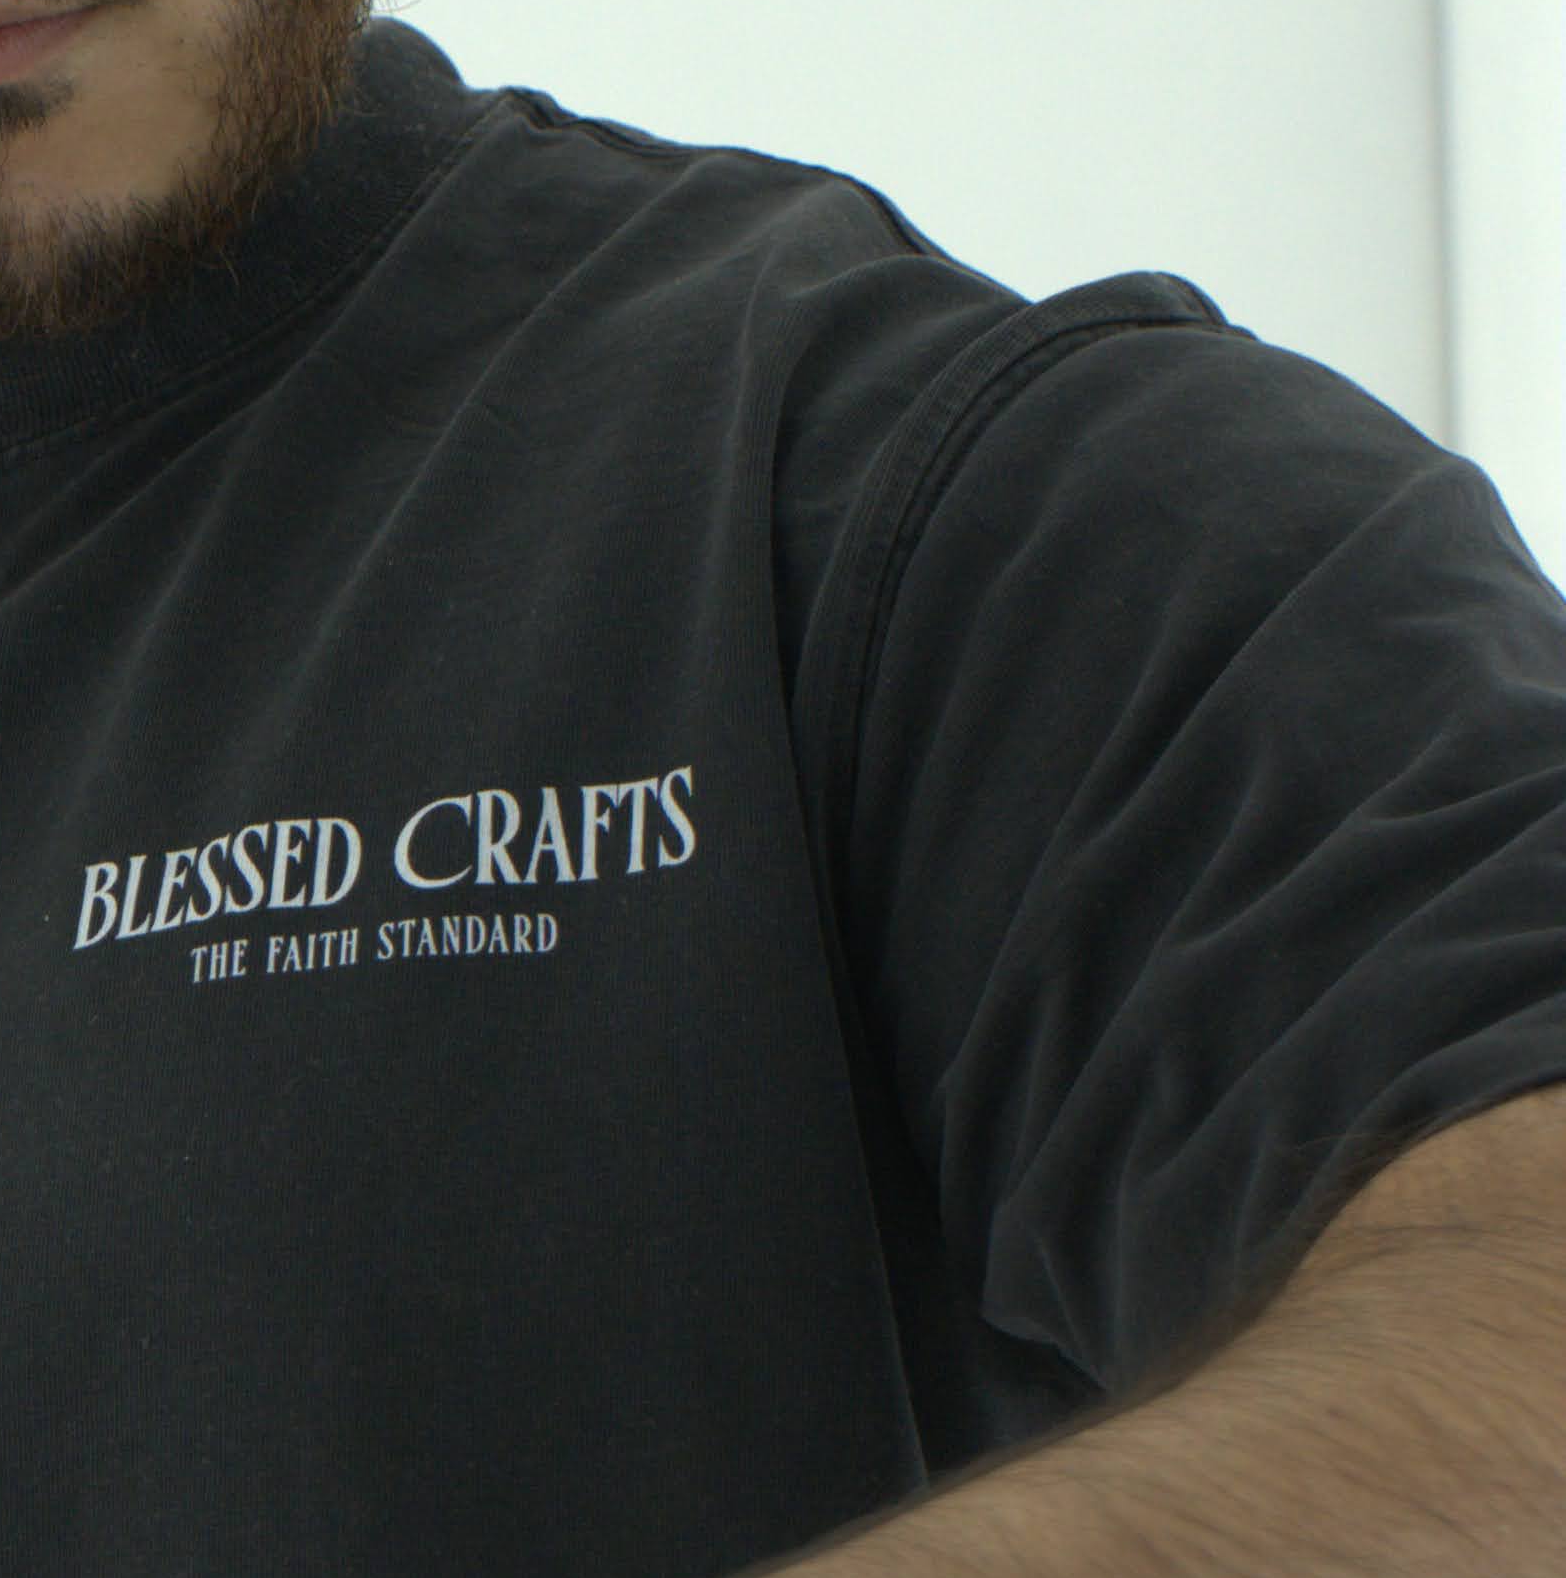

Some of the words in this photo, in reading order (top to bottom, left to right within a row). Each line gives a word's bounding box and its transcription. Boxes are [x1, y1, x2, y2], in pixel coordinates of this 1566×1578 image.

[72, 816, 362, 951] BLESSED
[393, 765, 697, 889] CRAFTS
[190, 938, 248, 984] THE
[266, 927, 359, 974] FAITH
[376, 913, 558, 961] STANDARD
